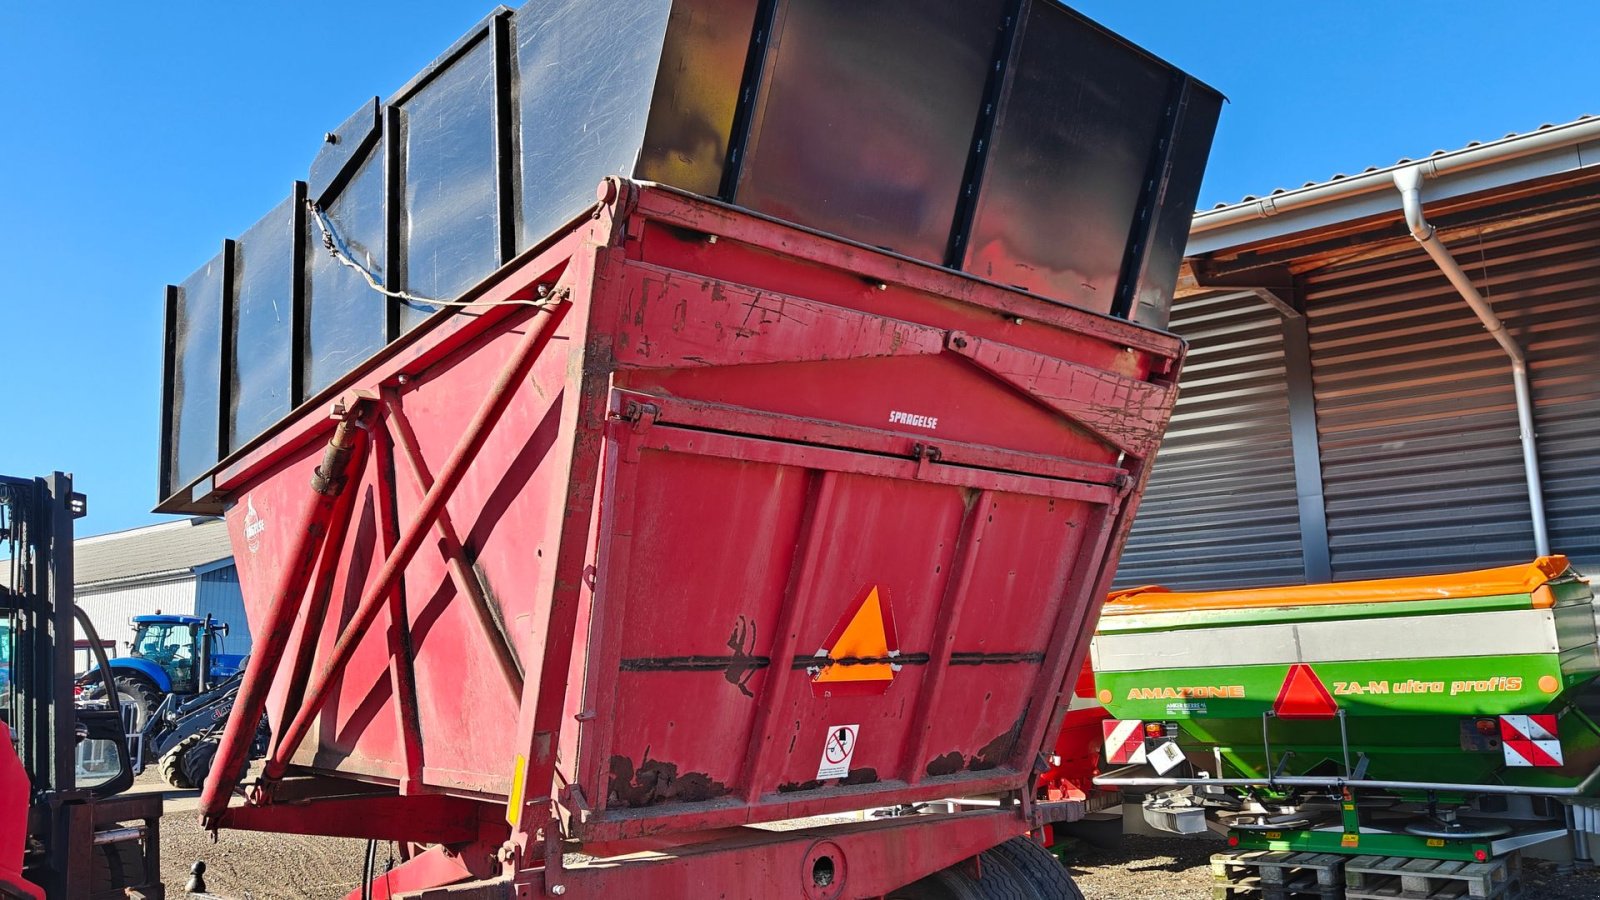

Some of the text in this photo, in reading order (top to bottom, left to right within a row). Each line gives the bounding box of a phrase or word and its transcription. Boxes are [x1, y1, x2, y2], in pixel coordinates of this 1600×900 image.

[889, 410, 938, 429] SPRAGELSE
[1127, 685, 1245, 700] AMAZONE
[1333, 677, 1522, 696] ZA-M ultra profiS
